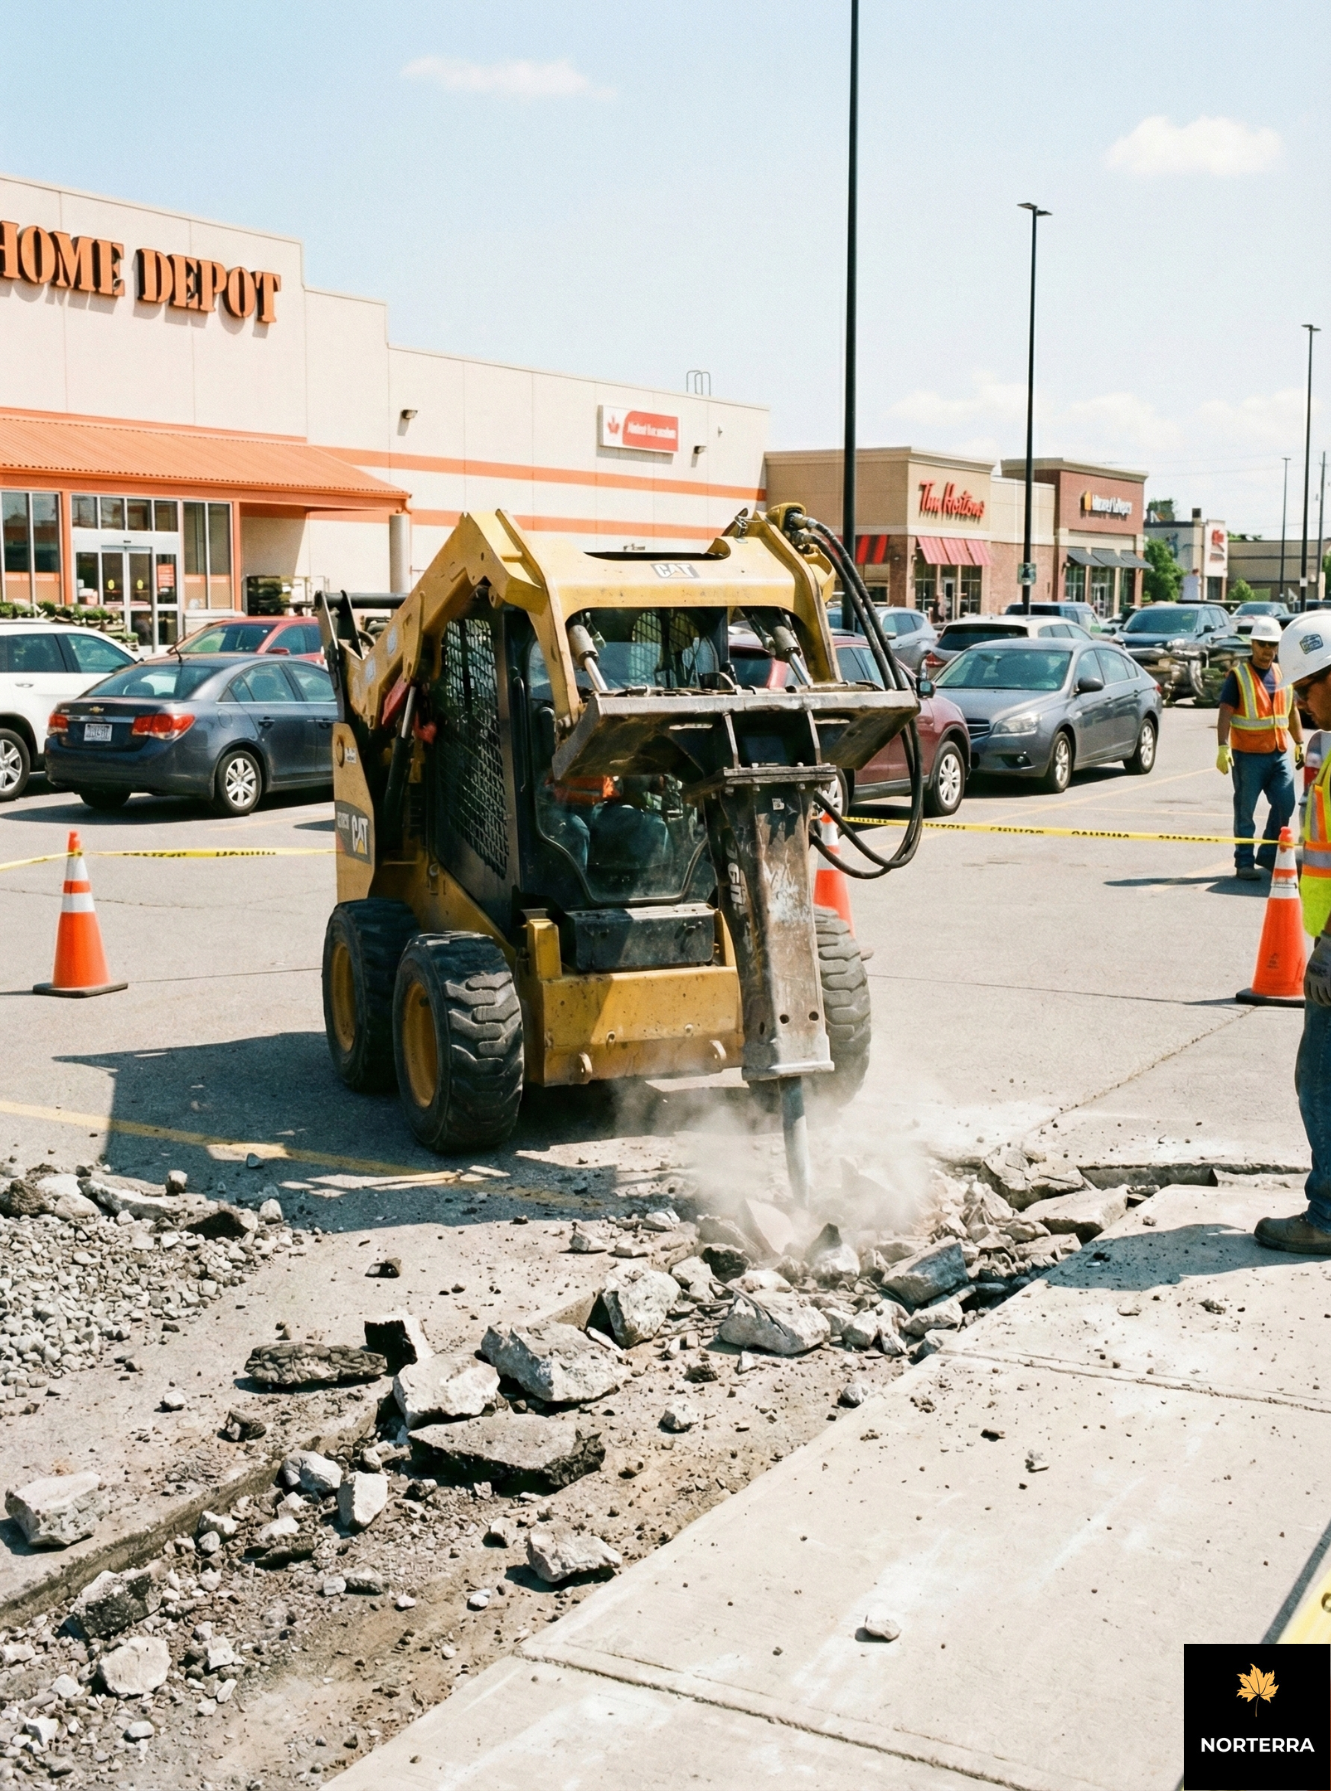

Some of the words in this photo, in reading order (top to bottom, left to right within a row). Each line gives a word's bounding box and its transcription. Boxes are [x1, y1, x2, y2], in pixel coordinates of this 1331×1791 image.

[135, 248, 281, 323] DEPOT
[919, 481, 940, 513] Tim
[941, 482, 985, 518] Hortons
[653, 563, 695, 578] CAT
[351, 815, 368, 855] CAT
